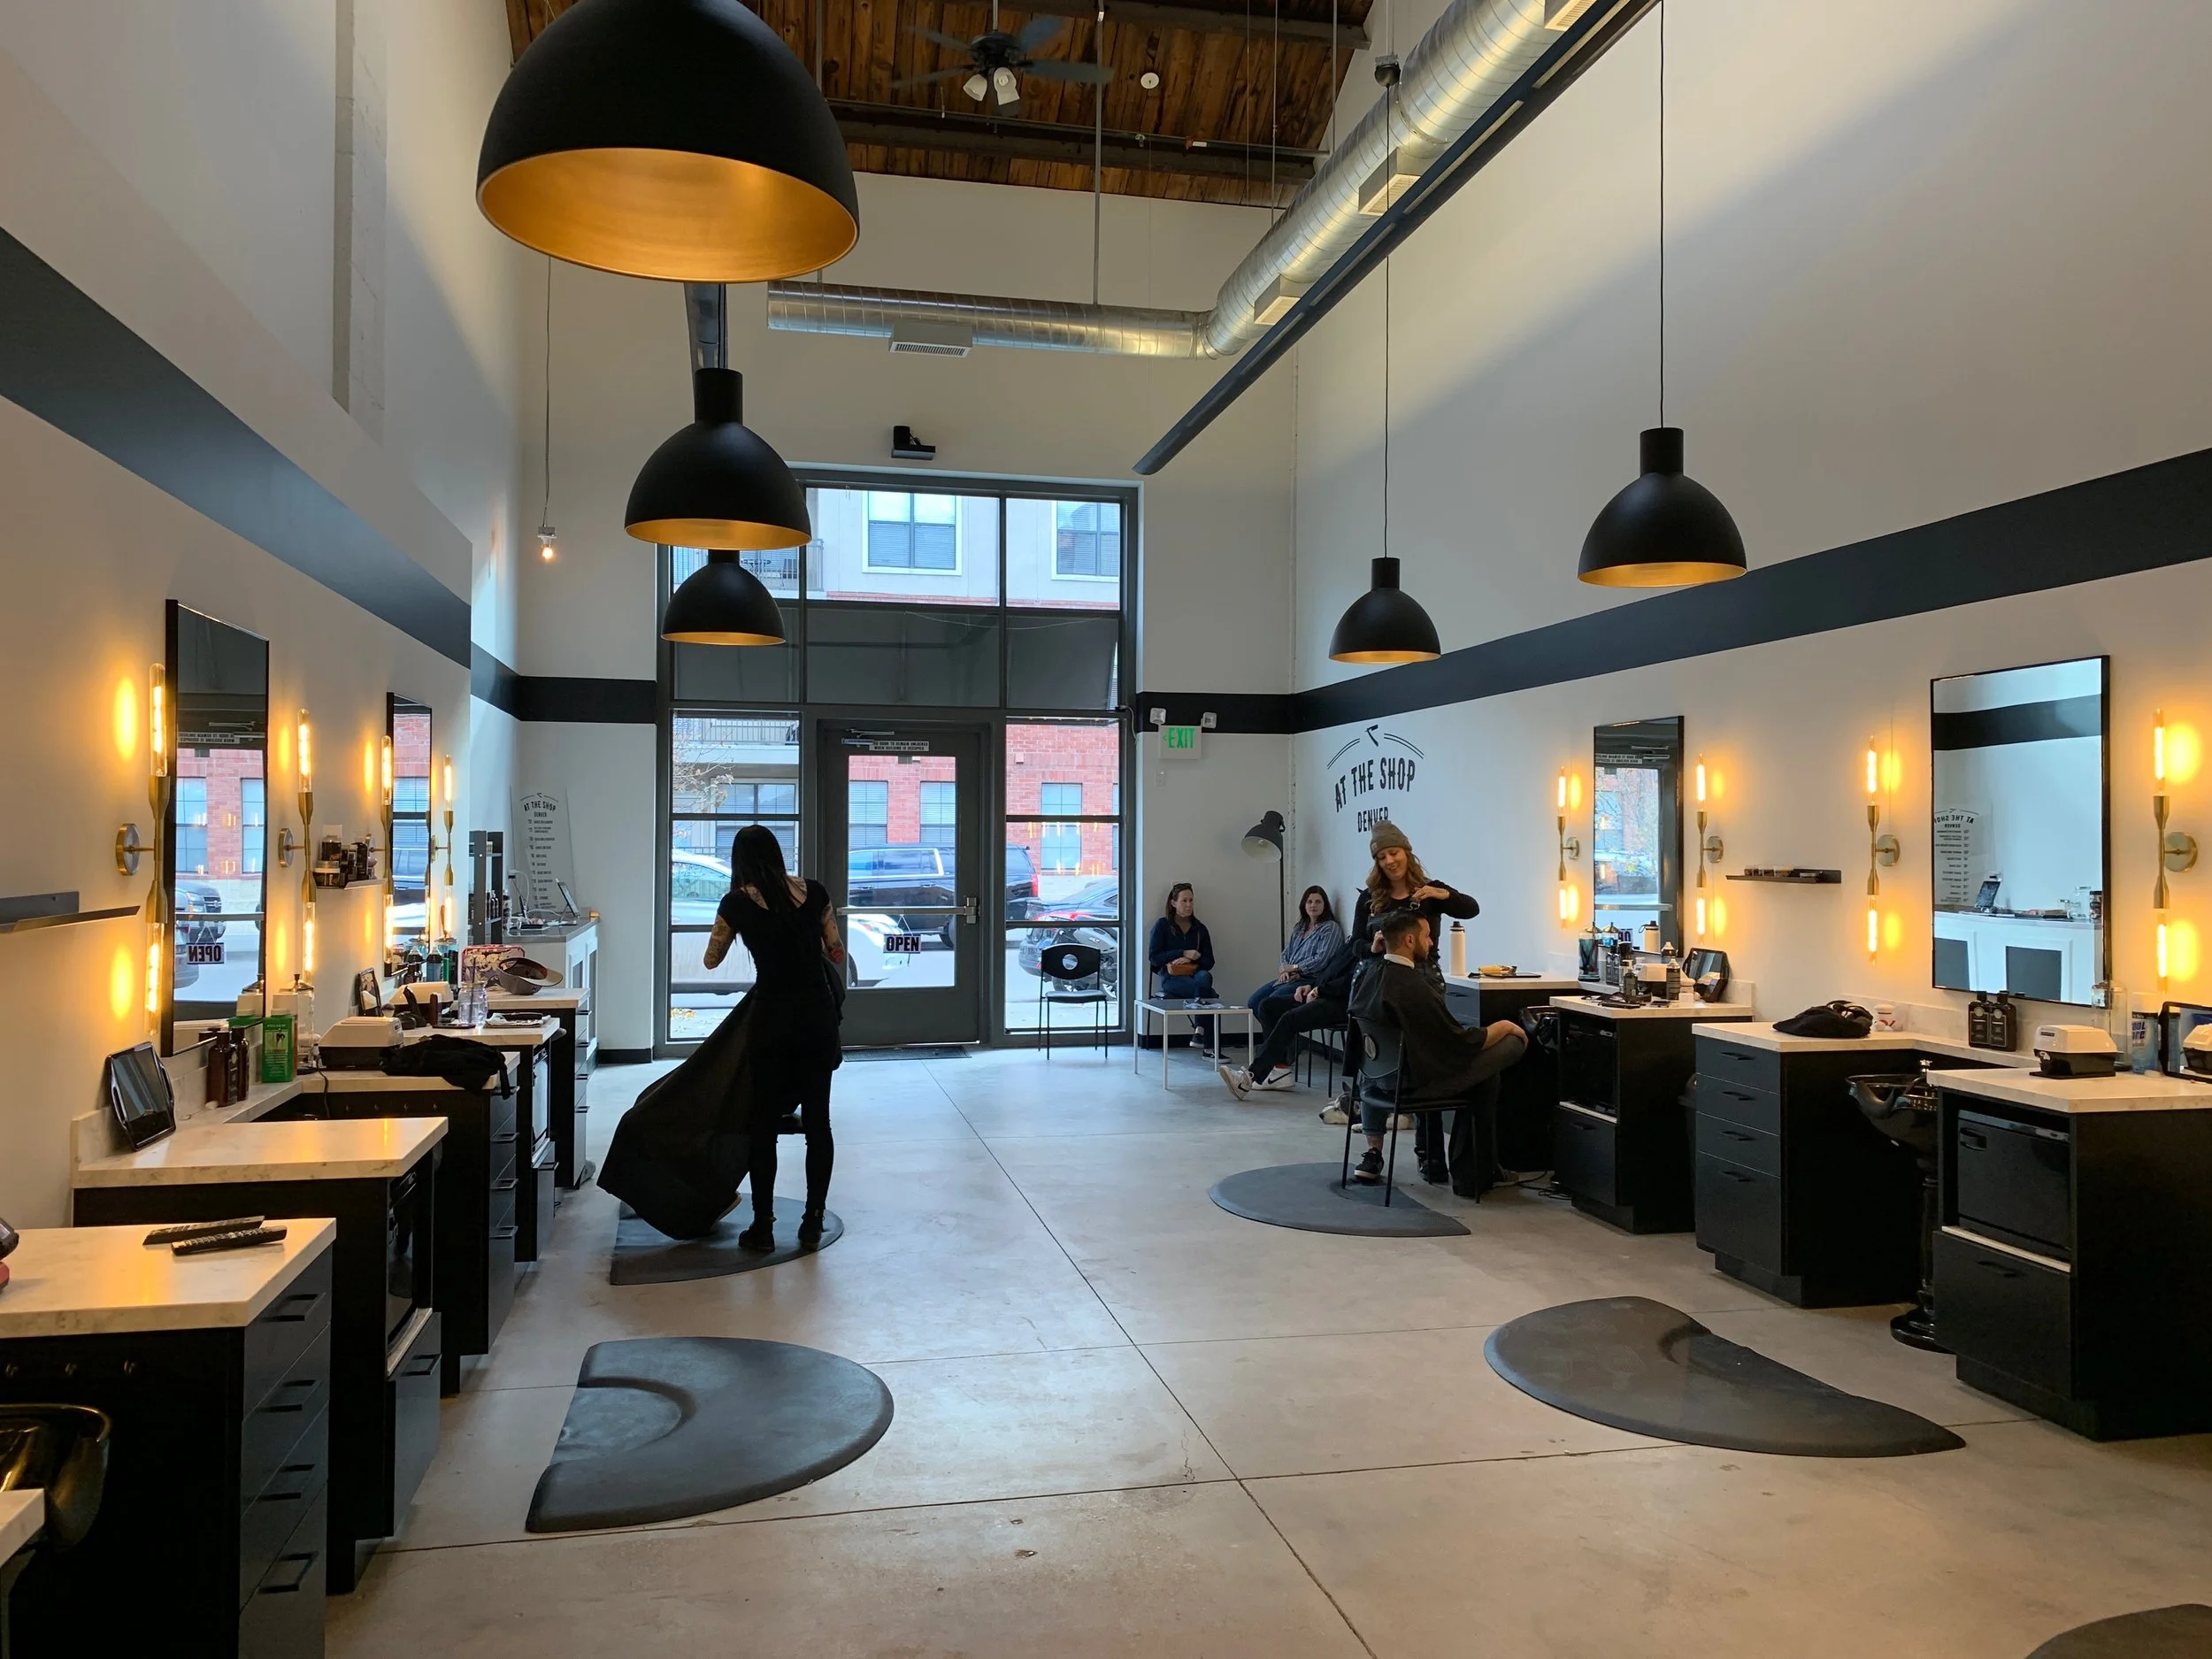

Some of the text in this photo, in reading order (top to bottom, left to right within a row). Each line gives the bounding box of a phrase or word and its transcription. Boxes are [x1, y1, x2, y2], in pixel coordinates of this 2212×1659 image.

[1168, 727, 1194, 749] EXIT
[1334, 757, 1416, 813] AT THE SHOP
[524, 800, 556, 812] AT THE SHOP
[886, 936, 919, 952] OPEN
